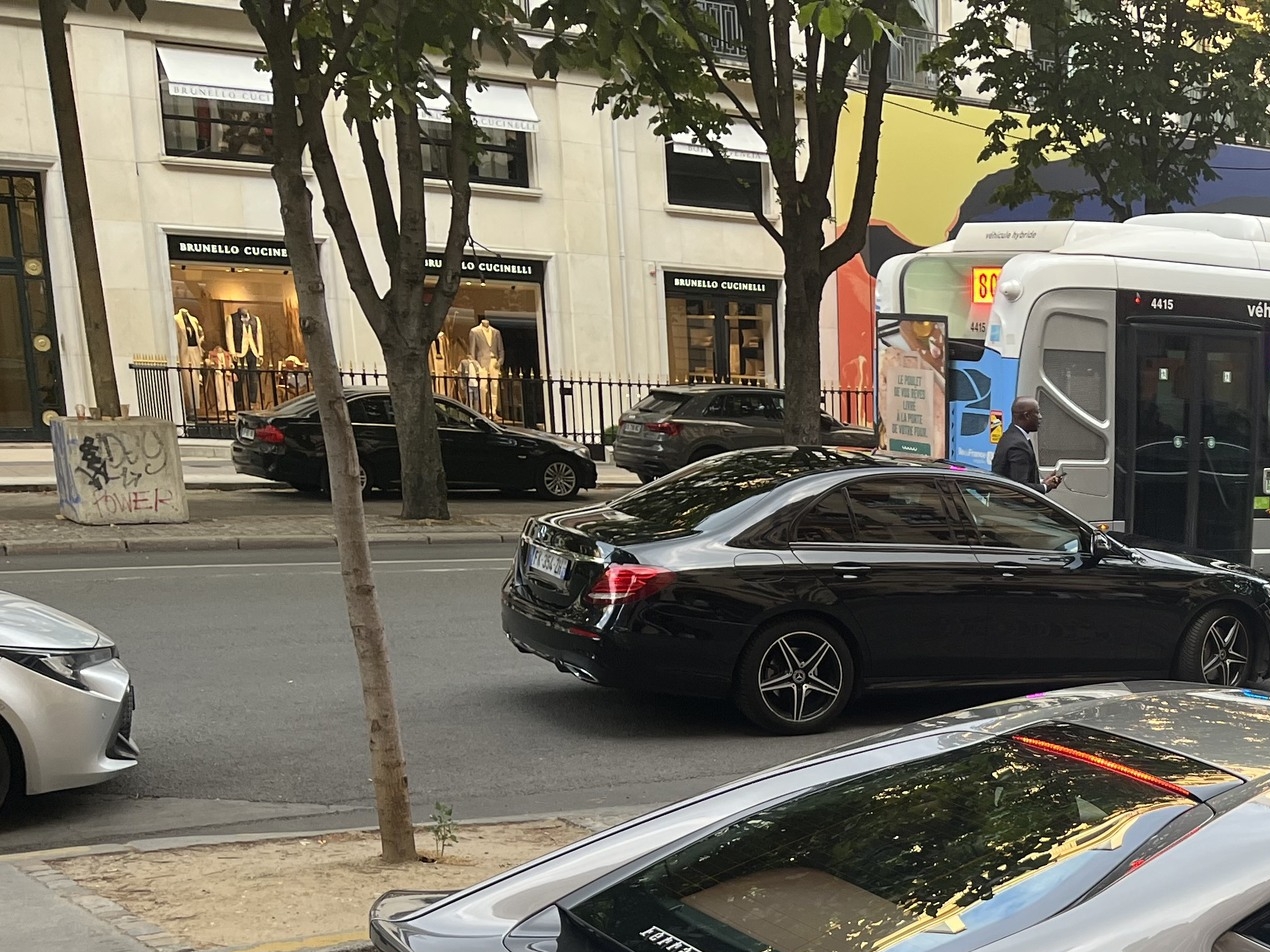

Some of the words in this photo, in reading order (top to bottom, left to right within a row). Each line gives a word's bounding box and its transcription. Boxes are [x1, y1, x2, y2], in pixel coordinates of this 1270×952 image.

[173, 86, 236, 98] BRUNELLO
[179, 242, 239, 255] BRUNELLO
[243, 246, 288, 258] CUCINE
[478, 262, 532, 275] CUCINELLI
[674, 278, 719, 289] BRUNELLO
[720, 281, 766, 292] CUCINELLI
[1150, 297, 1174, 311] 4415
[970, 322, 986, 333] 4415
